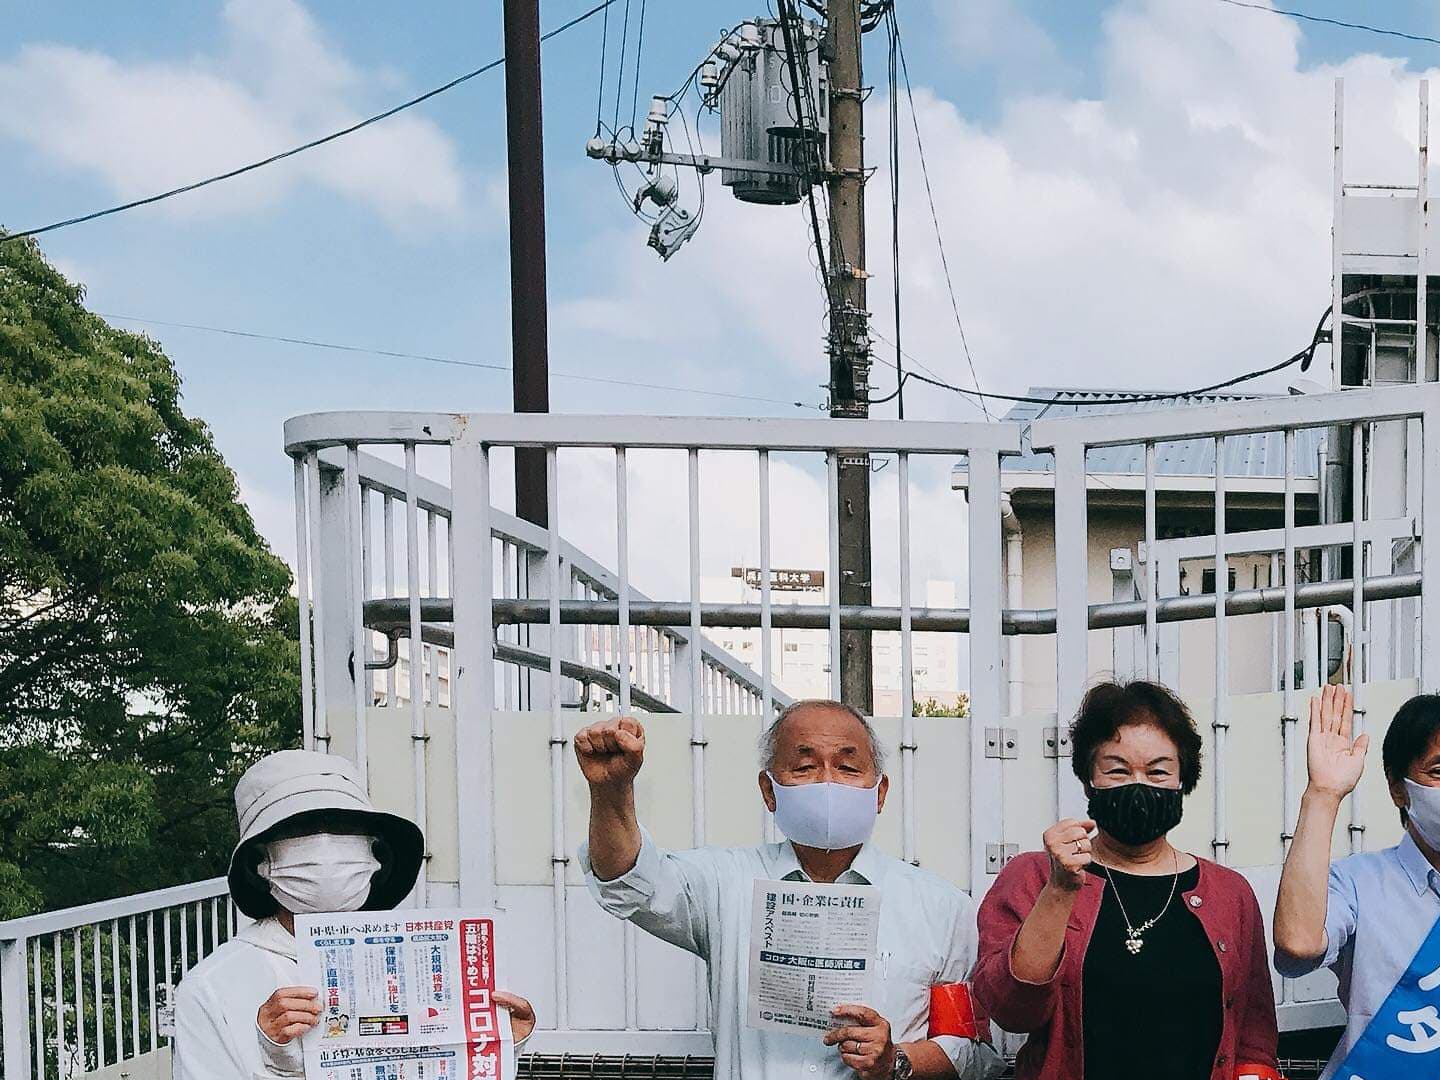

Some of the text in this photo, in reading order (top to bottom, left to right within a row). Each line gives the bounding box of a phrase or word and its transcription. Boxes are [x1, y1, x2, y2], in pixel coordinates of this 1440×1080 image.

[782, 893, 865, 909] 国・企業に責任
[405, 920, 455, 932] 日本共産党
